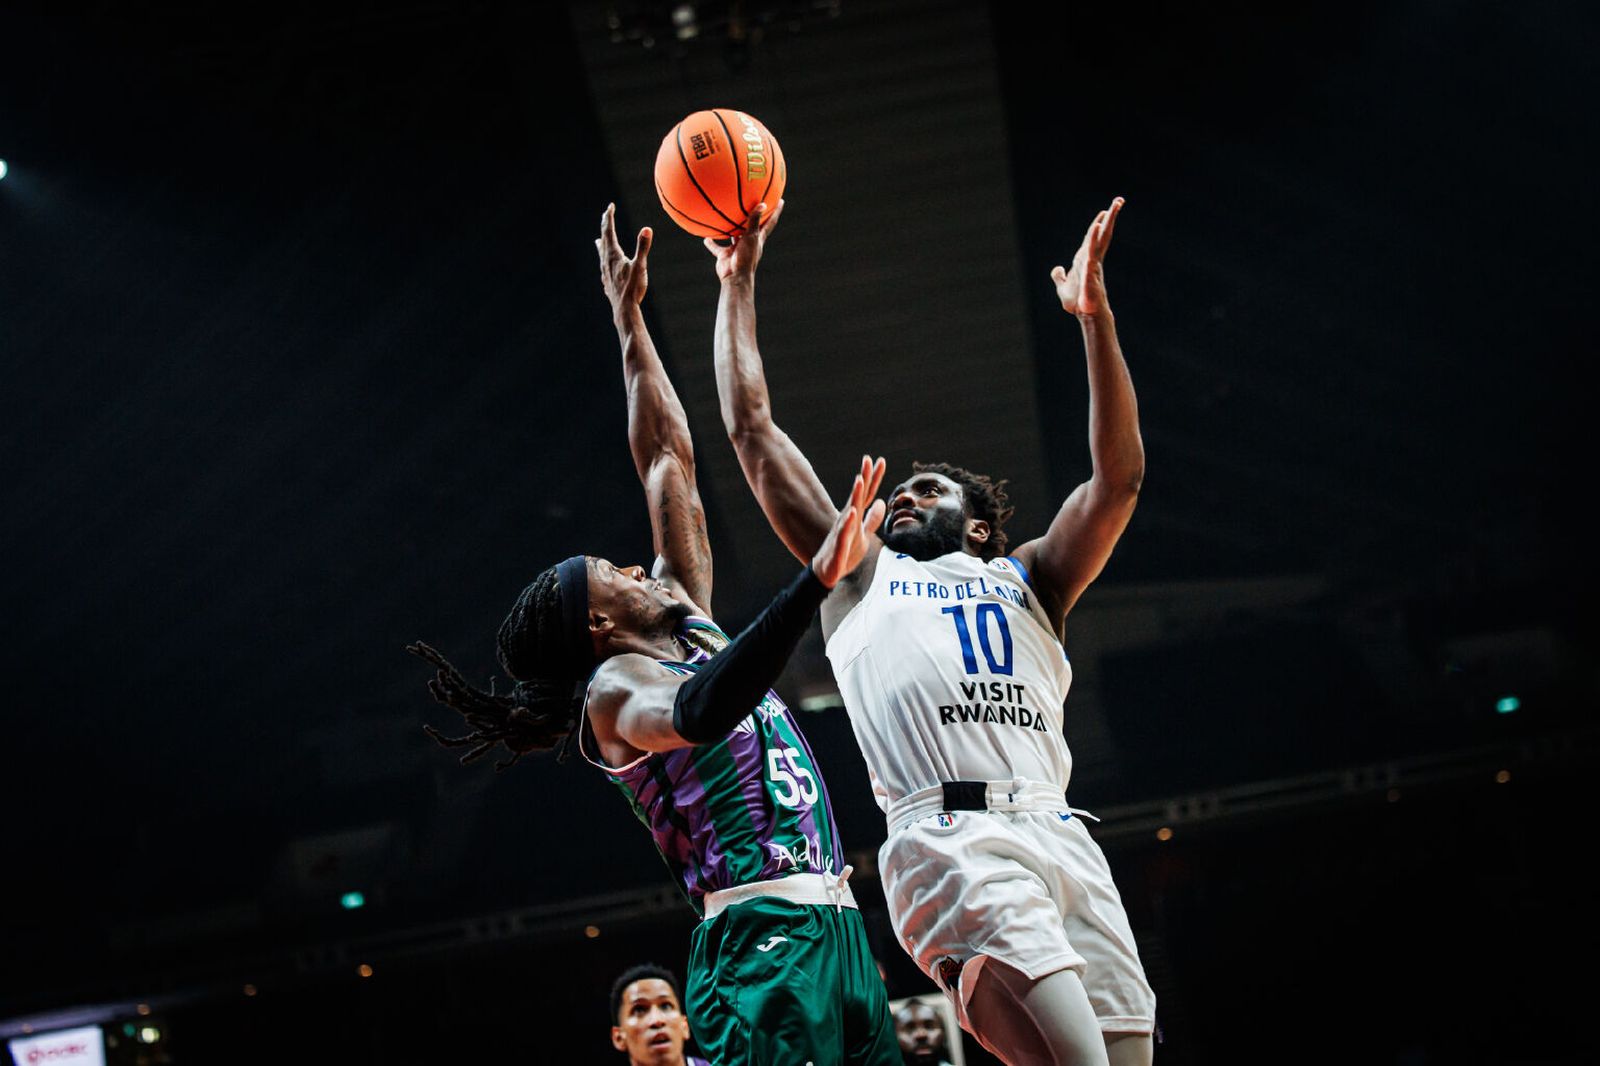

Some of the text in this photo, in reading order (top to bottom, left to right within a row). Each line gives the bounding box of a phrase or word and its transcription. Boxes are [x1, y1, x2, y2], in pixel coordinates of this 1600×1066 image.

[690, 133, 710, 160] FIBA
[889, 580, 949, 599] PETRO
[955, 581, 977, 600] DE
[941, 603, 1014, 676] 10
[959, 682, 1025, 704] VISIT
[938, 703, 1048, 732] RWANDA
[767, 747, 819, 807] 55
